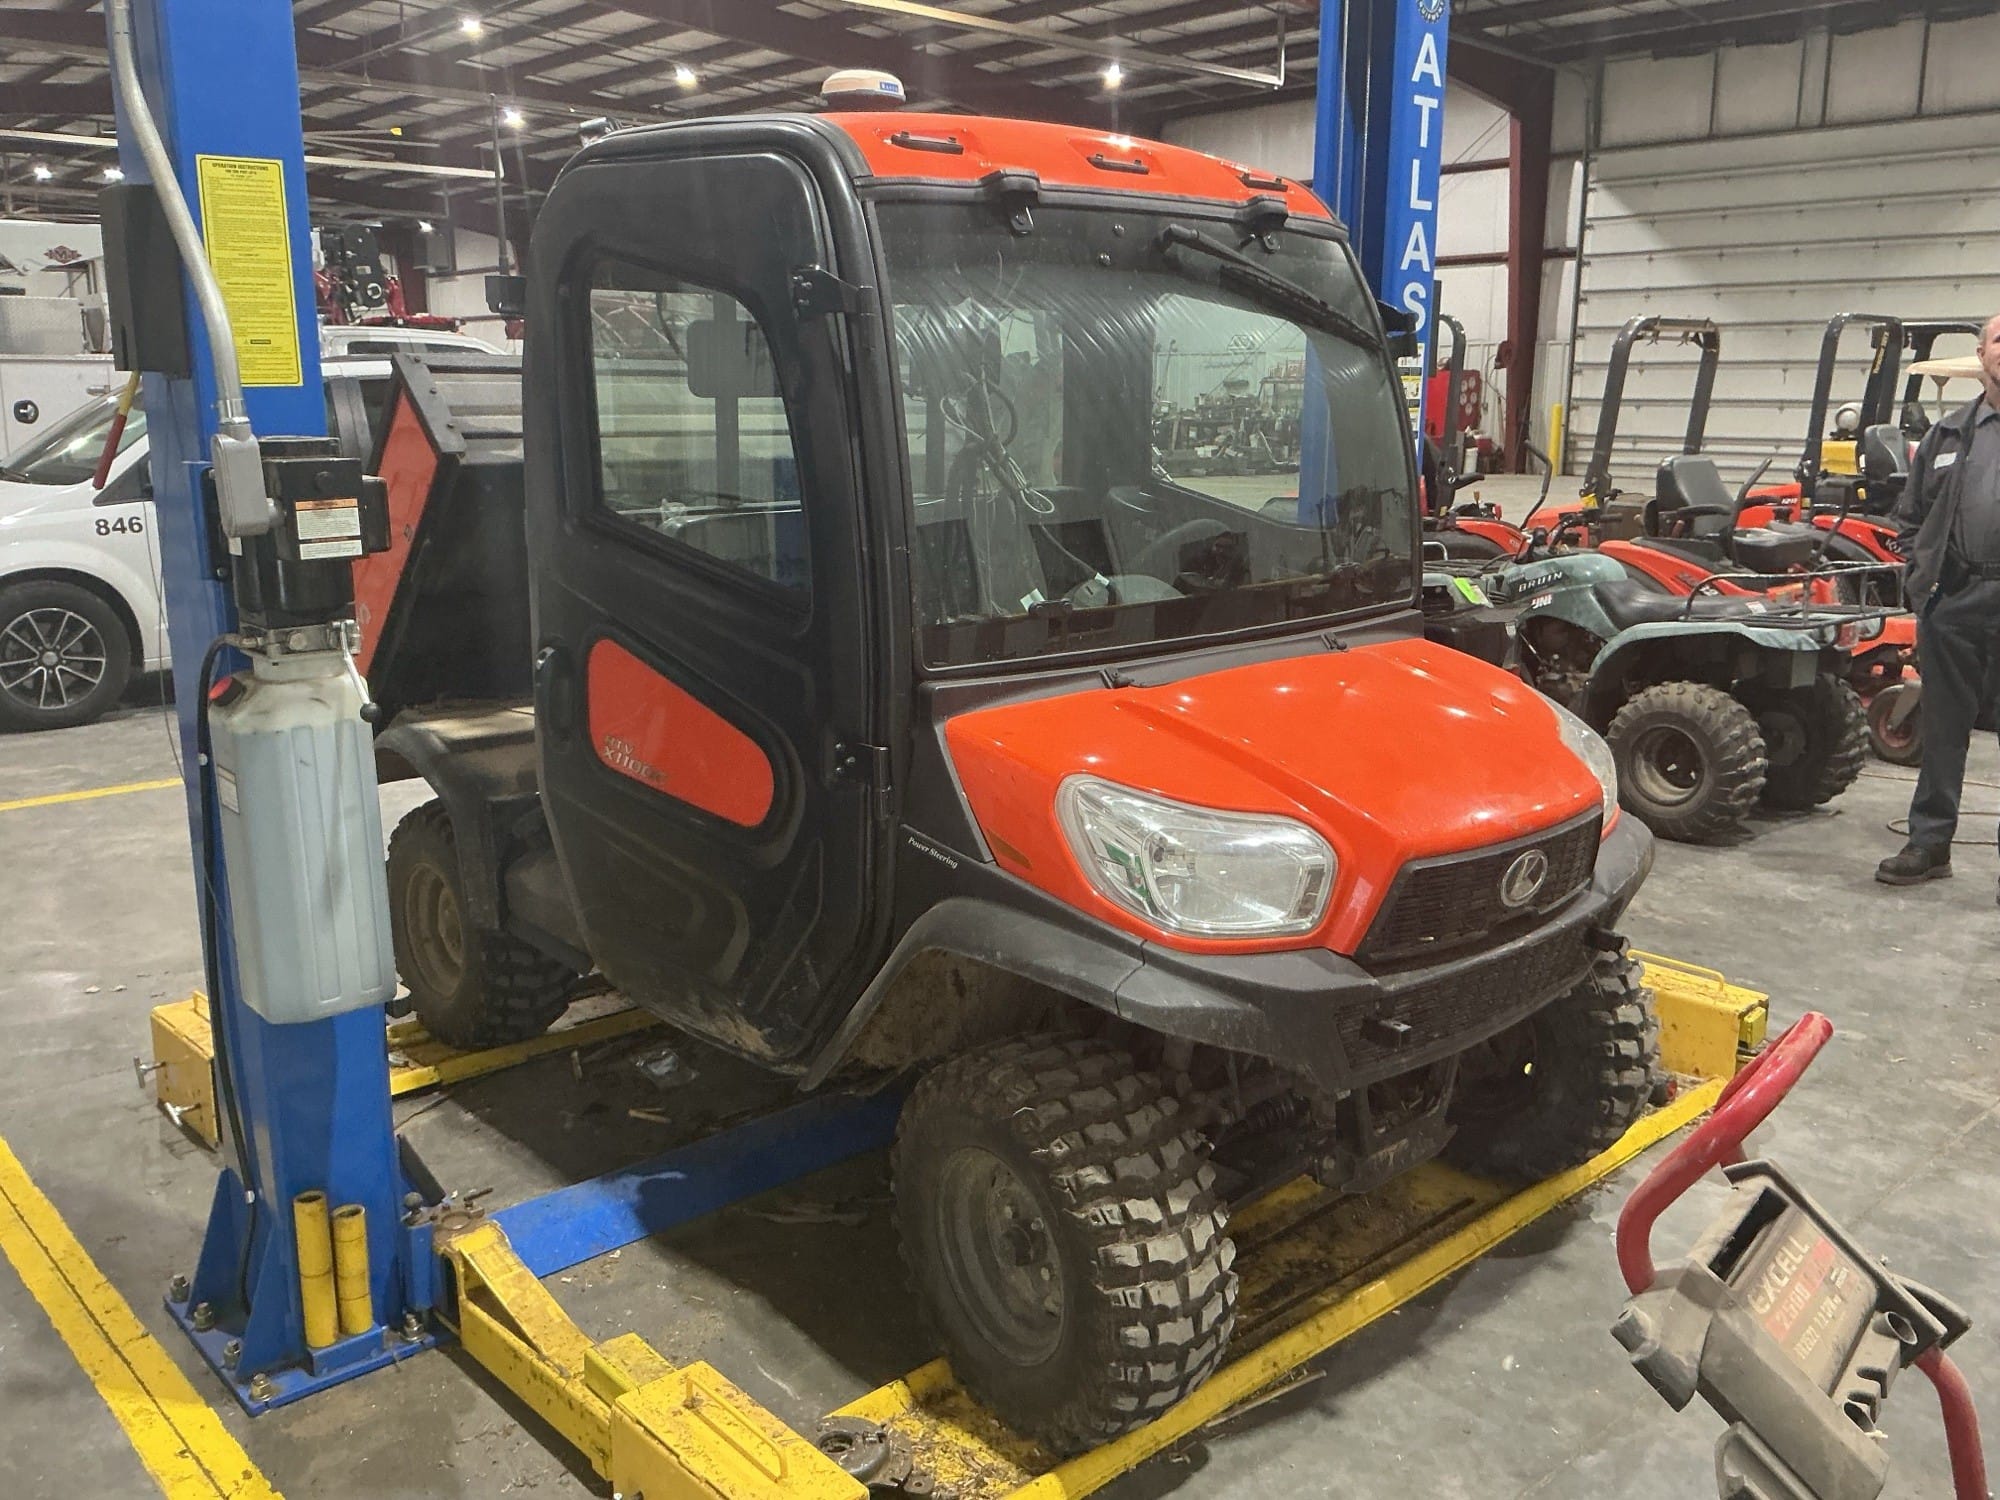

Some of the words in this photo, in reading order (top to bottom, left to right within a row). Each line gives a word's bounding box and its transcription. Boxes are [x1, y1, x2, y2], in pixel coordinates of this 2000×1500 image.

[1400, 32, 1442, 334] ATLAS
[95, 516, 143, 536] 846
[907, 836, 930, 853] Power
[928, 847, 959, 870] Steering
[1748, 1236, 1810, 1315] EXCELL
